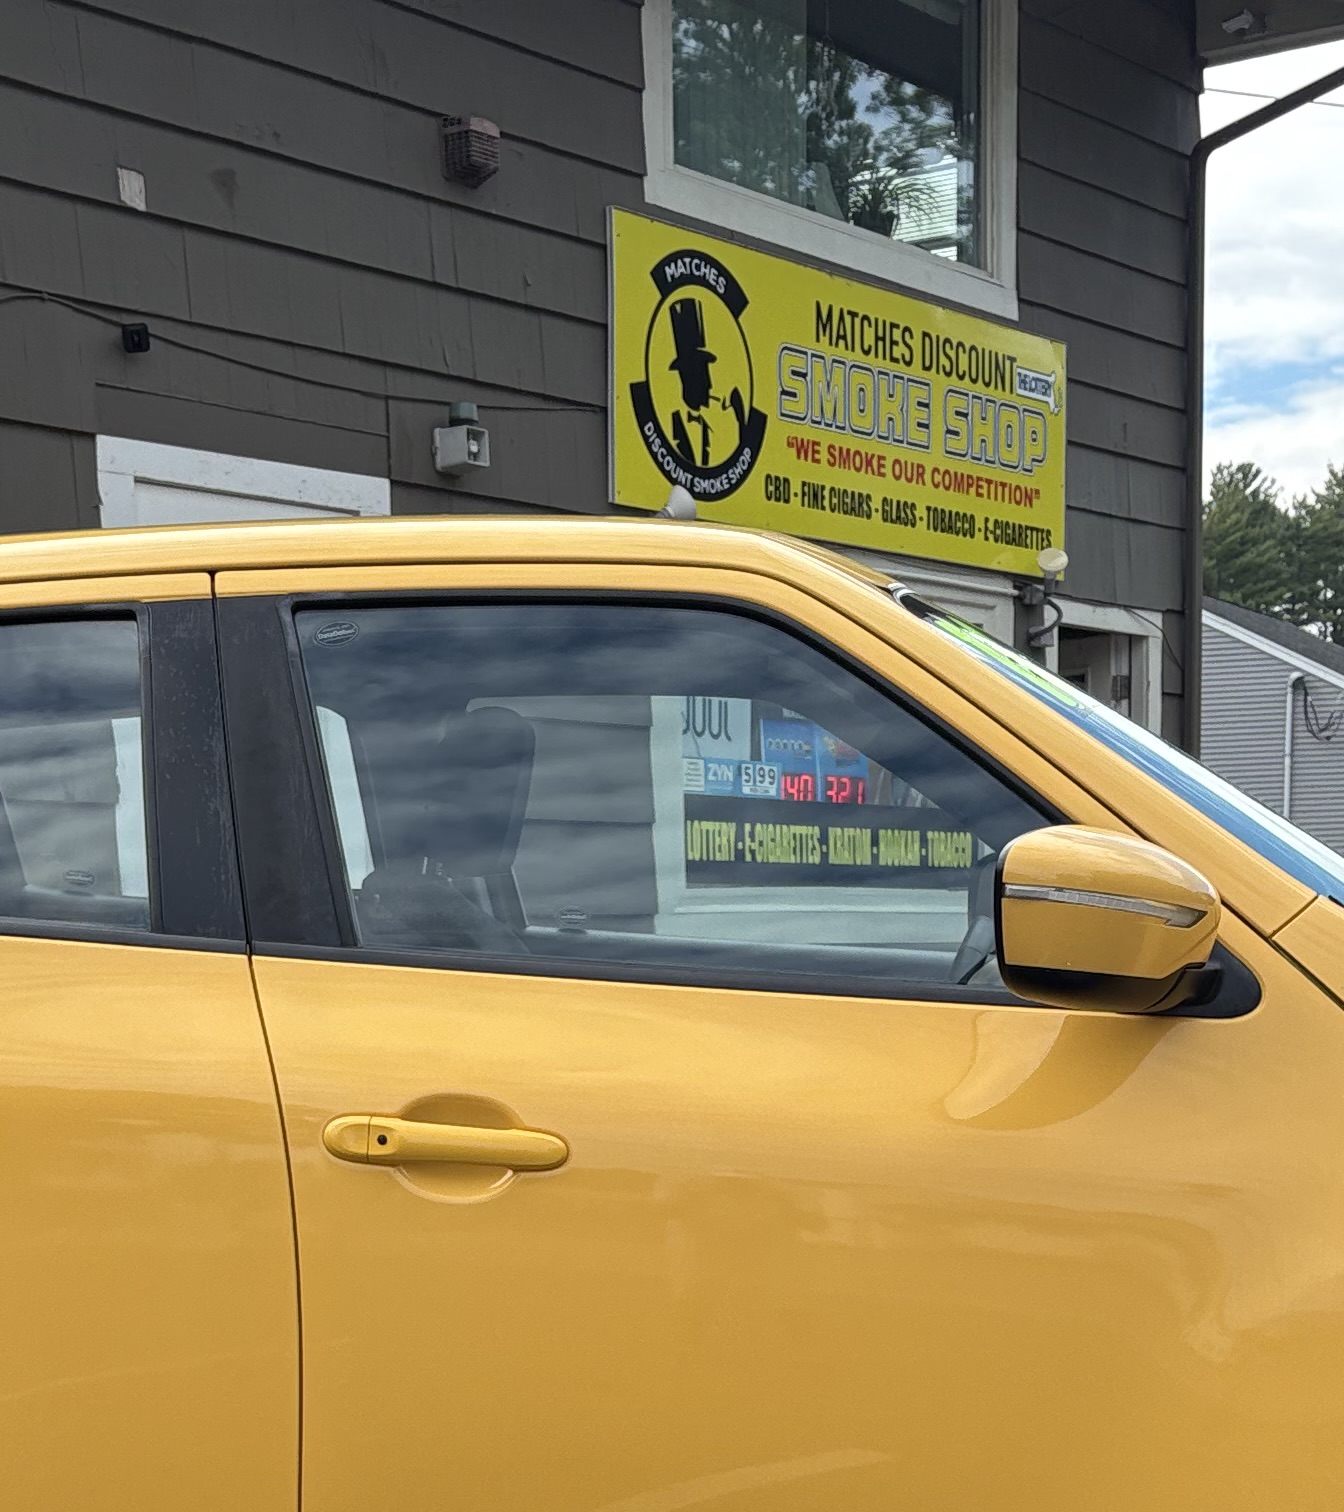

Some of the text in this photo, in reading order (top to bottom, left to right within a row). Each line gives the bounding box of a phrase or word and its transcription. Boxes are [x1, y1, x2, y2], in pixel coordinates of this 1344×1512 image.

[664, 257, 727, 295] MATCHES
[815, 300, 1017, 395] MATCHES DISCOUNT
[777, 342, 1048, 476] SMOKE SHOP
[644, 421, 753, 495] DISCOUNT SMOKE SHOP
[827, 446, 887, 479] SMOKE
[892, 458, 927, 486] OUR
[764, 473, 1052, 551] CBD FINE CIGARS GLASS TOBACCO E-CIGARETTES
[682, 696, 732, 741] JUUL
[707, 763, 734, 782] ZYN
[686, 820, 736, 861] LOTTERY
[744, 822, 821, 865] E-CIGARETTES
